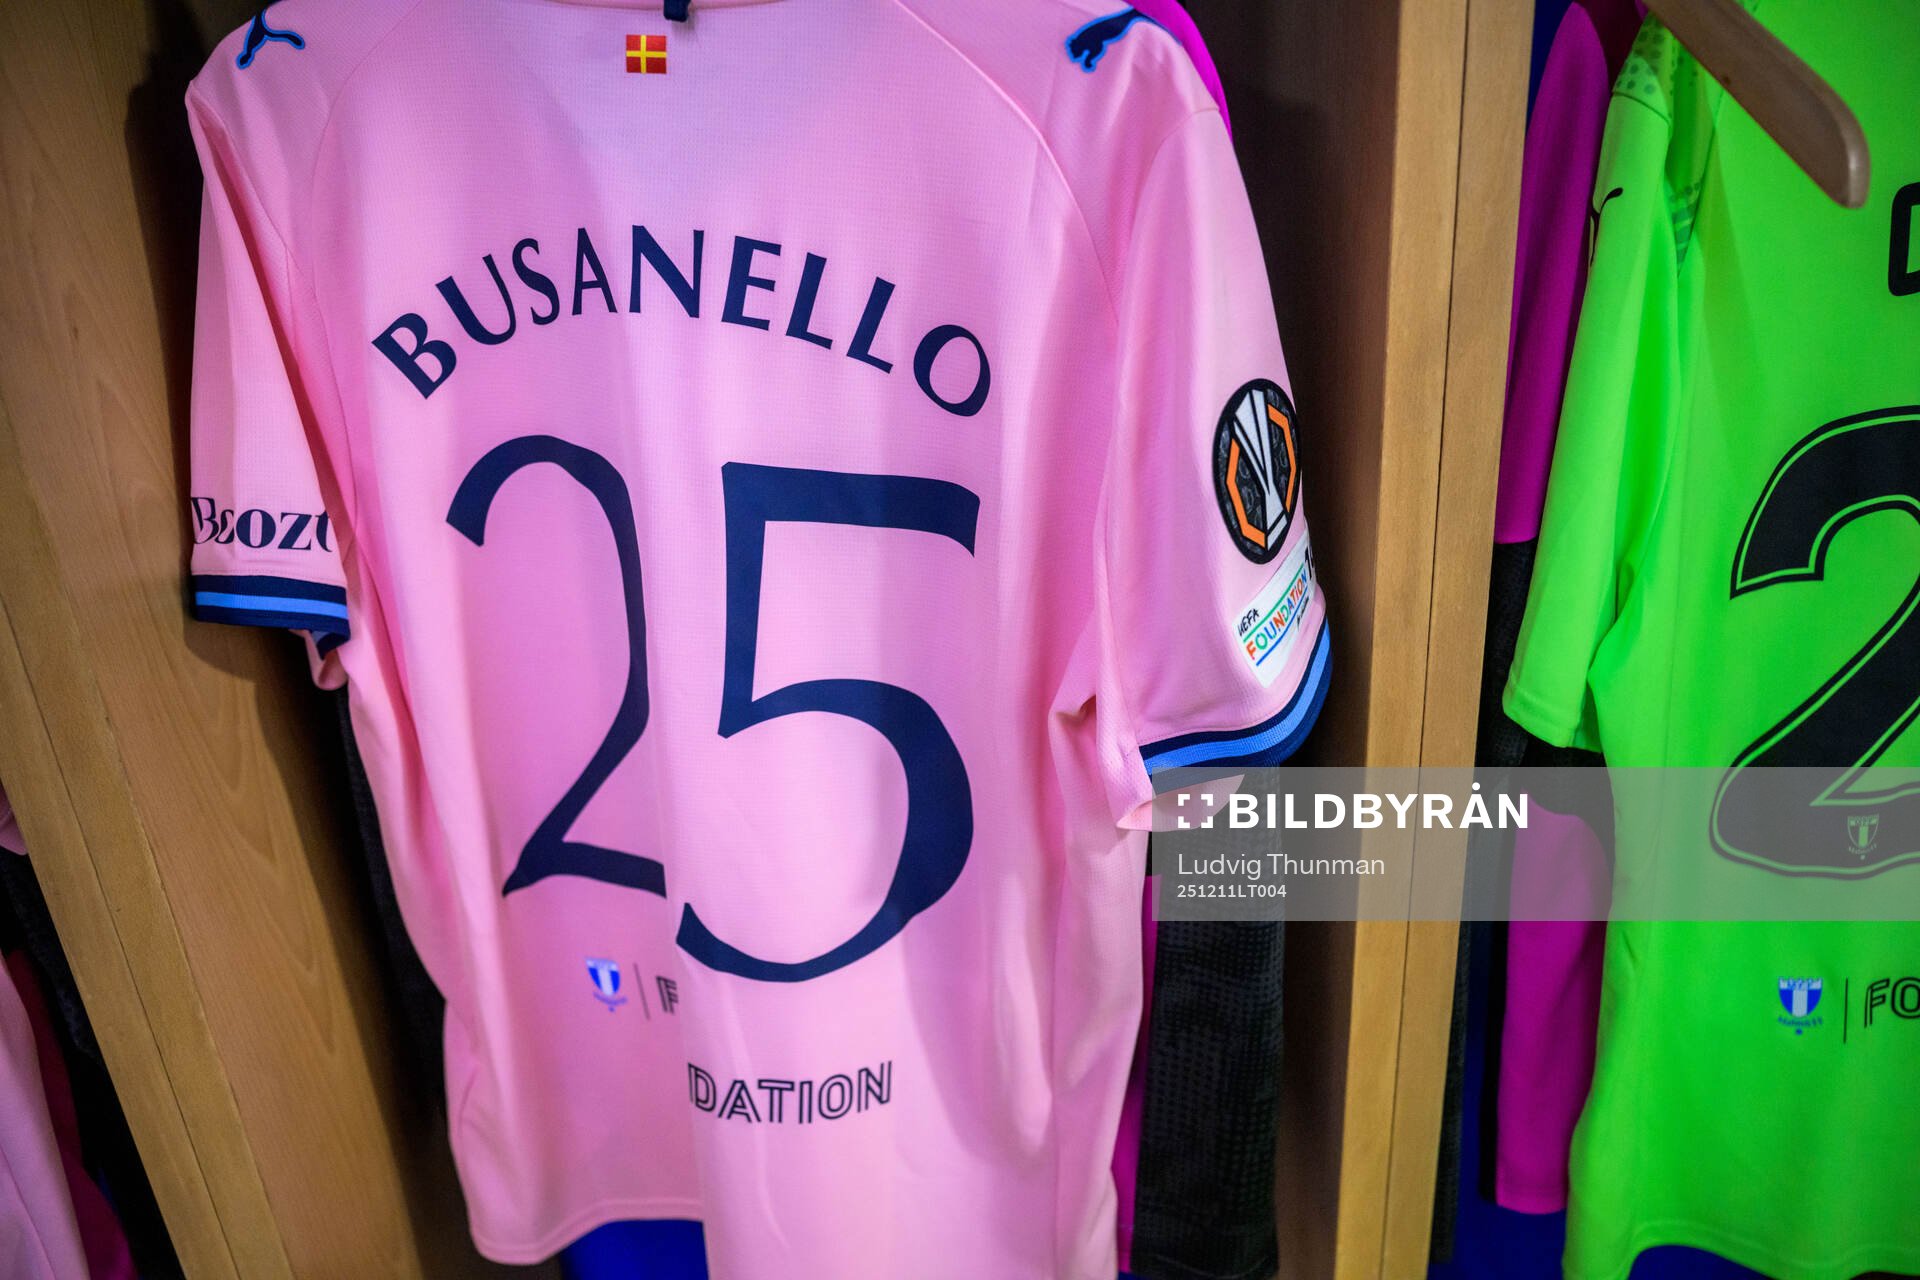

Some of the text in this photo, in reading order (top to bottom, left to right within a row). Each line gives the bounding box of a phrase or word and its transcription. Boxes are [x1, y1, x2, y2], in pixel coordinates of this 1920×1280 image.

[371, 224, 992, 418] BUSANELLO
[1238, 608, 1260, 637] UEFA
[1246, 569, 1308, 661] FOUNDATION
[445, 434, 981, 983] 25
